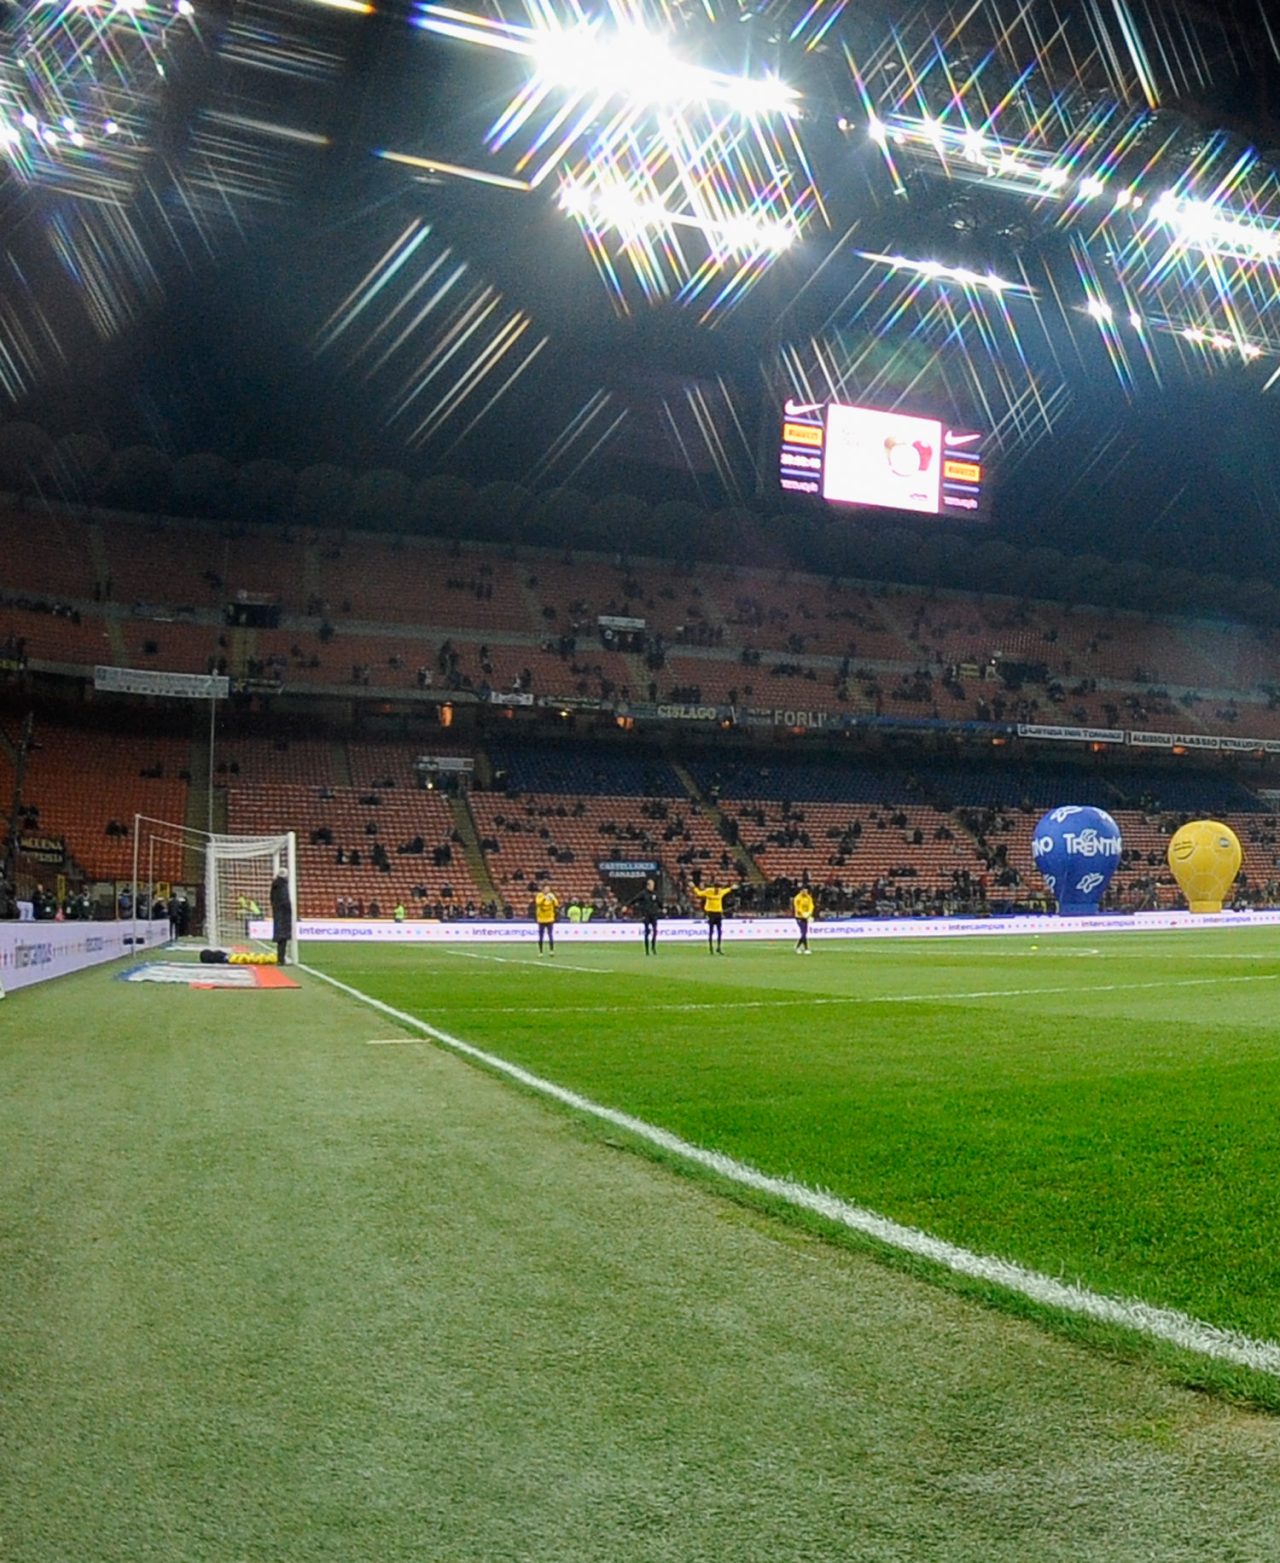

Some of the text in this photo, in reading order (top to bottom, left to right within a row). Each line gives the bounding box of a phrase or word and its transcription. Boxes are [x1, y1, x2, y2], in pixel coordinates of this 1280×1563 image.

[1176, 736, 1217, 747] ALASSIO
[298, 926, 373, 937] intercampus
[809, 926, 864, 934] tercampus
[948, 923, 1004, 932] intercampus
[1080, 919, 1136, 928] intercampus
[1202, 916, 1251, 924] intercampus
